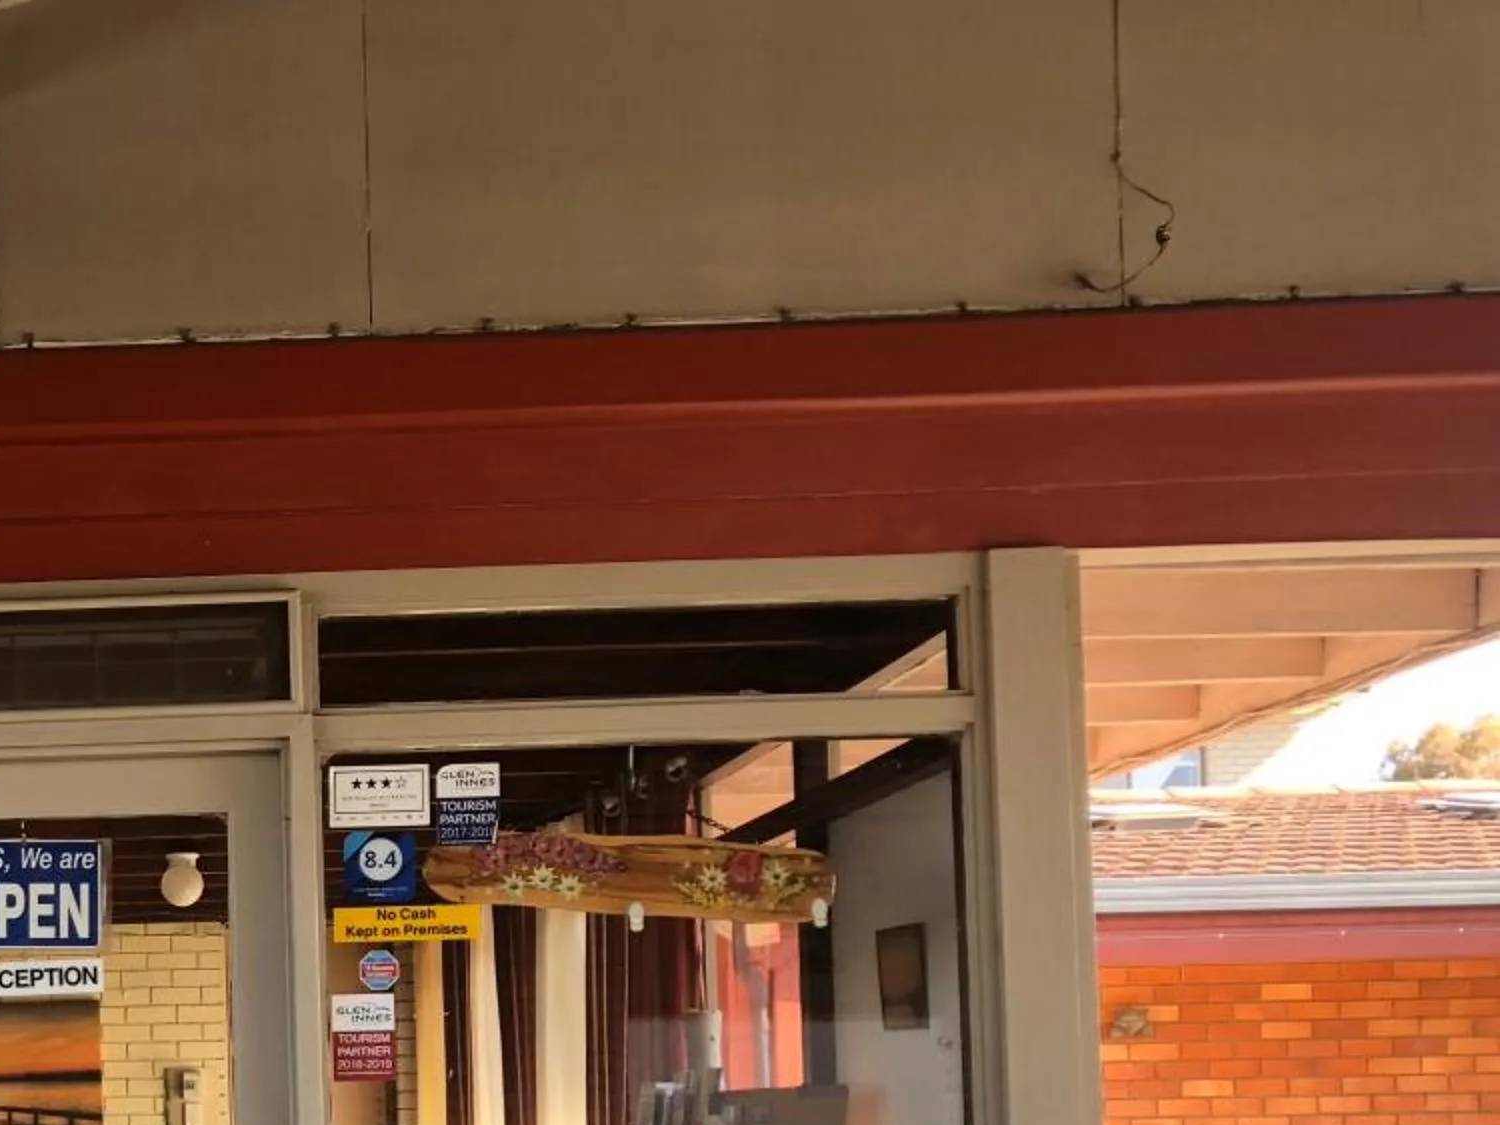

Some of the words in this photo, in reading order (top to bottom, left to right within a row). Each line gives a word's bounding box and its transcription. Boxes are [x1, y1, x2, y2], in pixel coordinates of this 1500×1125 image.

[441, 770, 475, 779] GLEN
[455, 778, 495, 787] INNES
[442, 799, 497, 812] TOURISM
[440, 812, 496, 825] PARTNER
[21, 847, 53, 870] We
[59, 851, 95, 870] are
[364, 850, 397, 869] 8.4
[376, 909, 396, 921] No
[400, 907, 437, 920] Cash
[345, 927, 379, 938] Kept
[382, 928, 400, 937] on
[404, 924, 468, 936] Premises
[336, 1006, 370, 1015] GLEN
[351, 1013, 392, 1022] INNES
[338, 1033, 391, 1044] TOURISM
[337, 1045, 391, 1057] PARTNER
